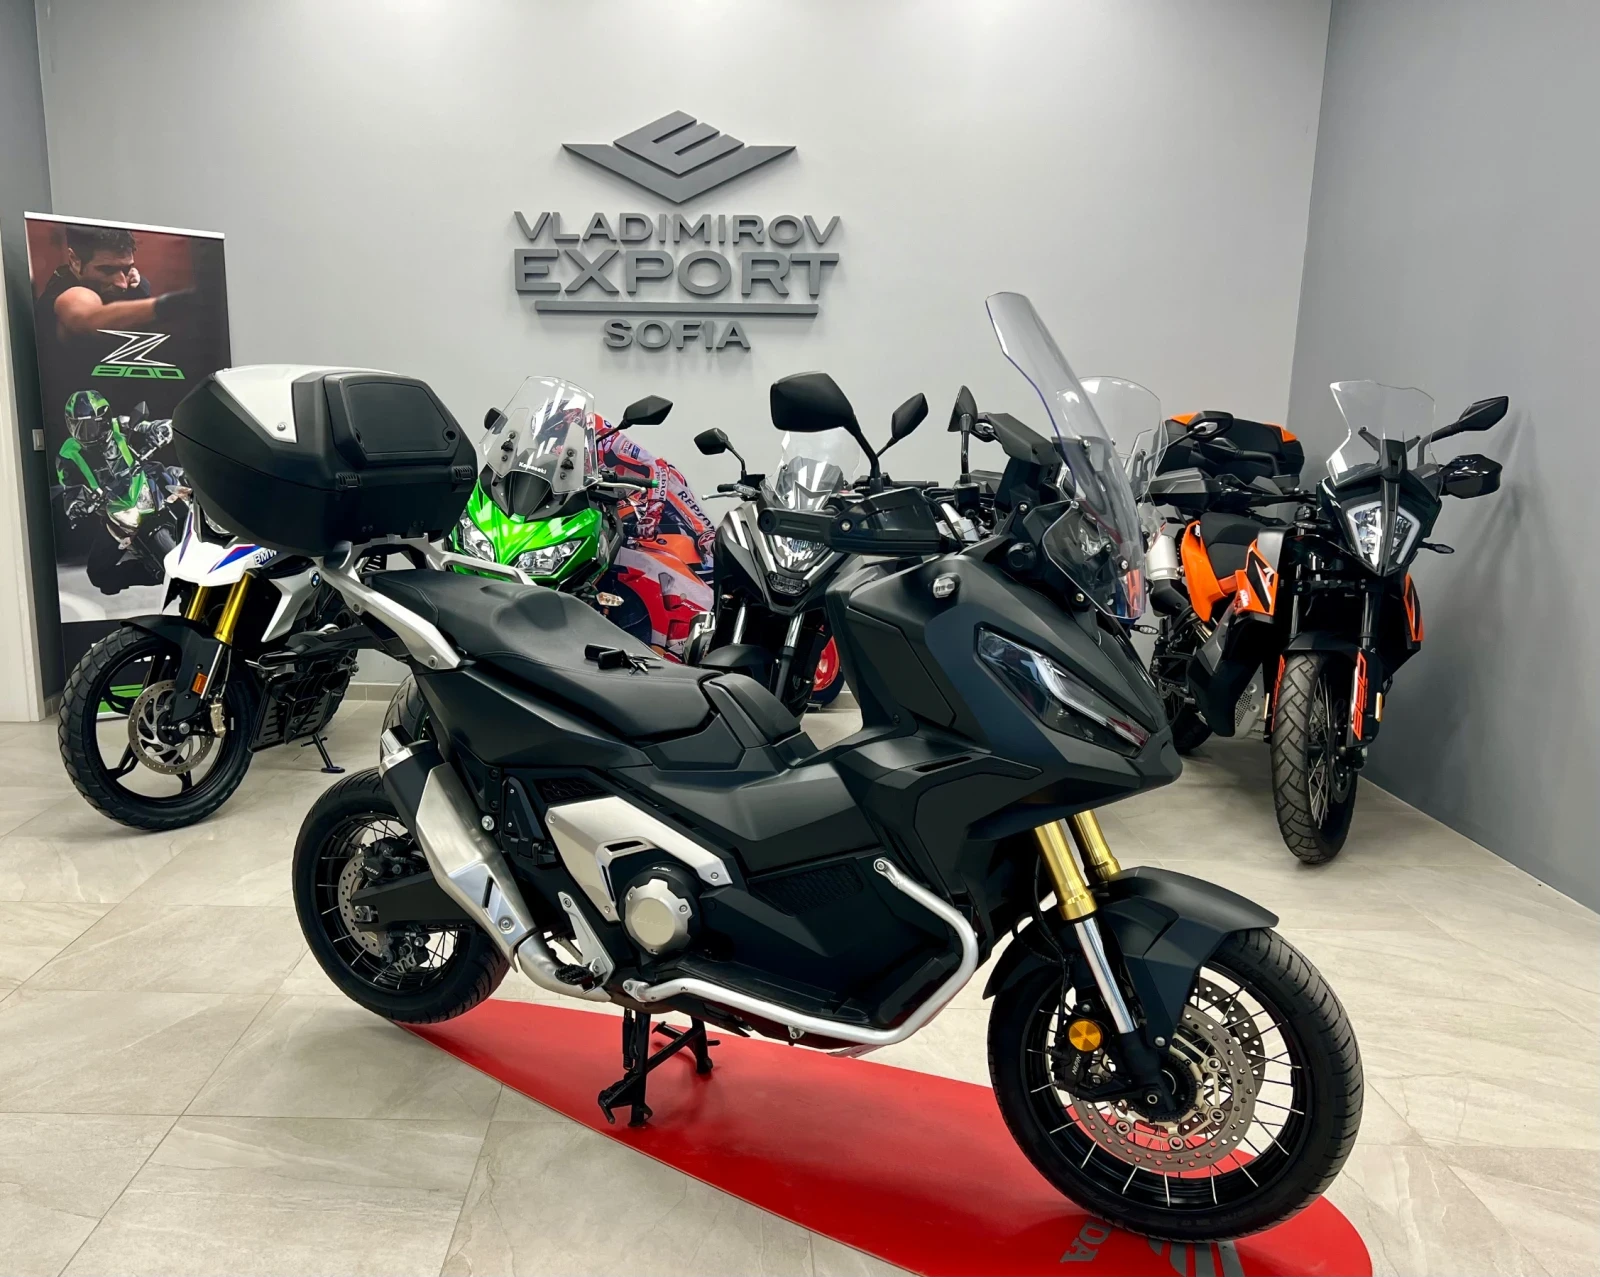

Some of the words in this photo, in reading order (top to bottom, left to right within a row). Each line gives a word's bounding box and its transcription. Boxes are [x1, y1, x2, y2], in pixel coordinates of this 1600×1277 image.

[513, 210, 841, 245] VLADIMIROV
[513, 248, 840, 296] EXPORT
[602, 318, 751, 351] SOFIA
[91, 365, 186, 380] 800
[253, 548, 278, 566] BMW
